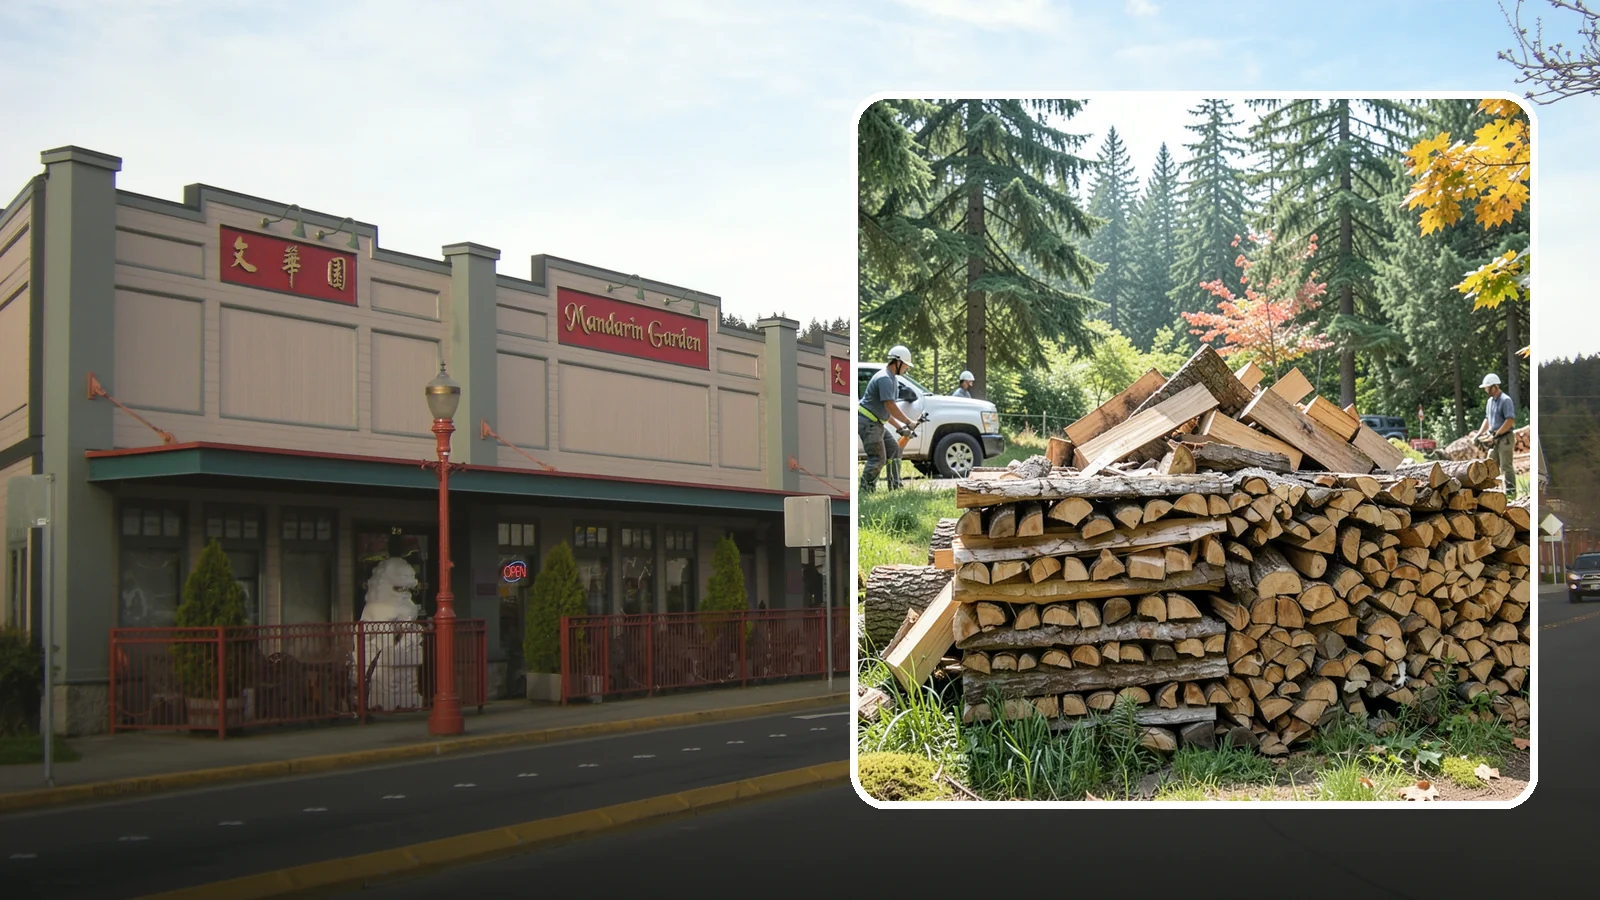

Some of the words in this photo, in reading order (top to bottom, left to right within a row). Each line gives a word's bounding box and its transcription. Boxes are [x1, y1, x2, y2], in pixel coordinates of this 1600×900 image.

[231, 236, 346, 291] 文華園
[565, 302, 644, 341] Mandarin
[648, 320, 701, 352] Garden
[503, 565, 527, 578] OPEN
